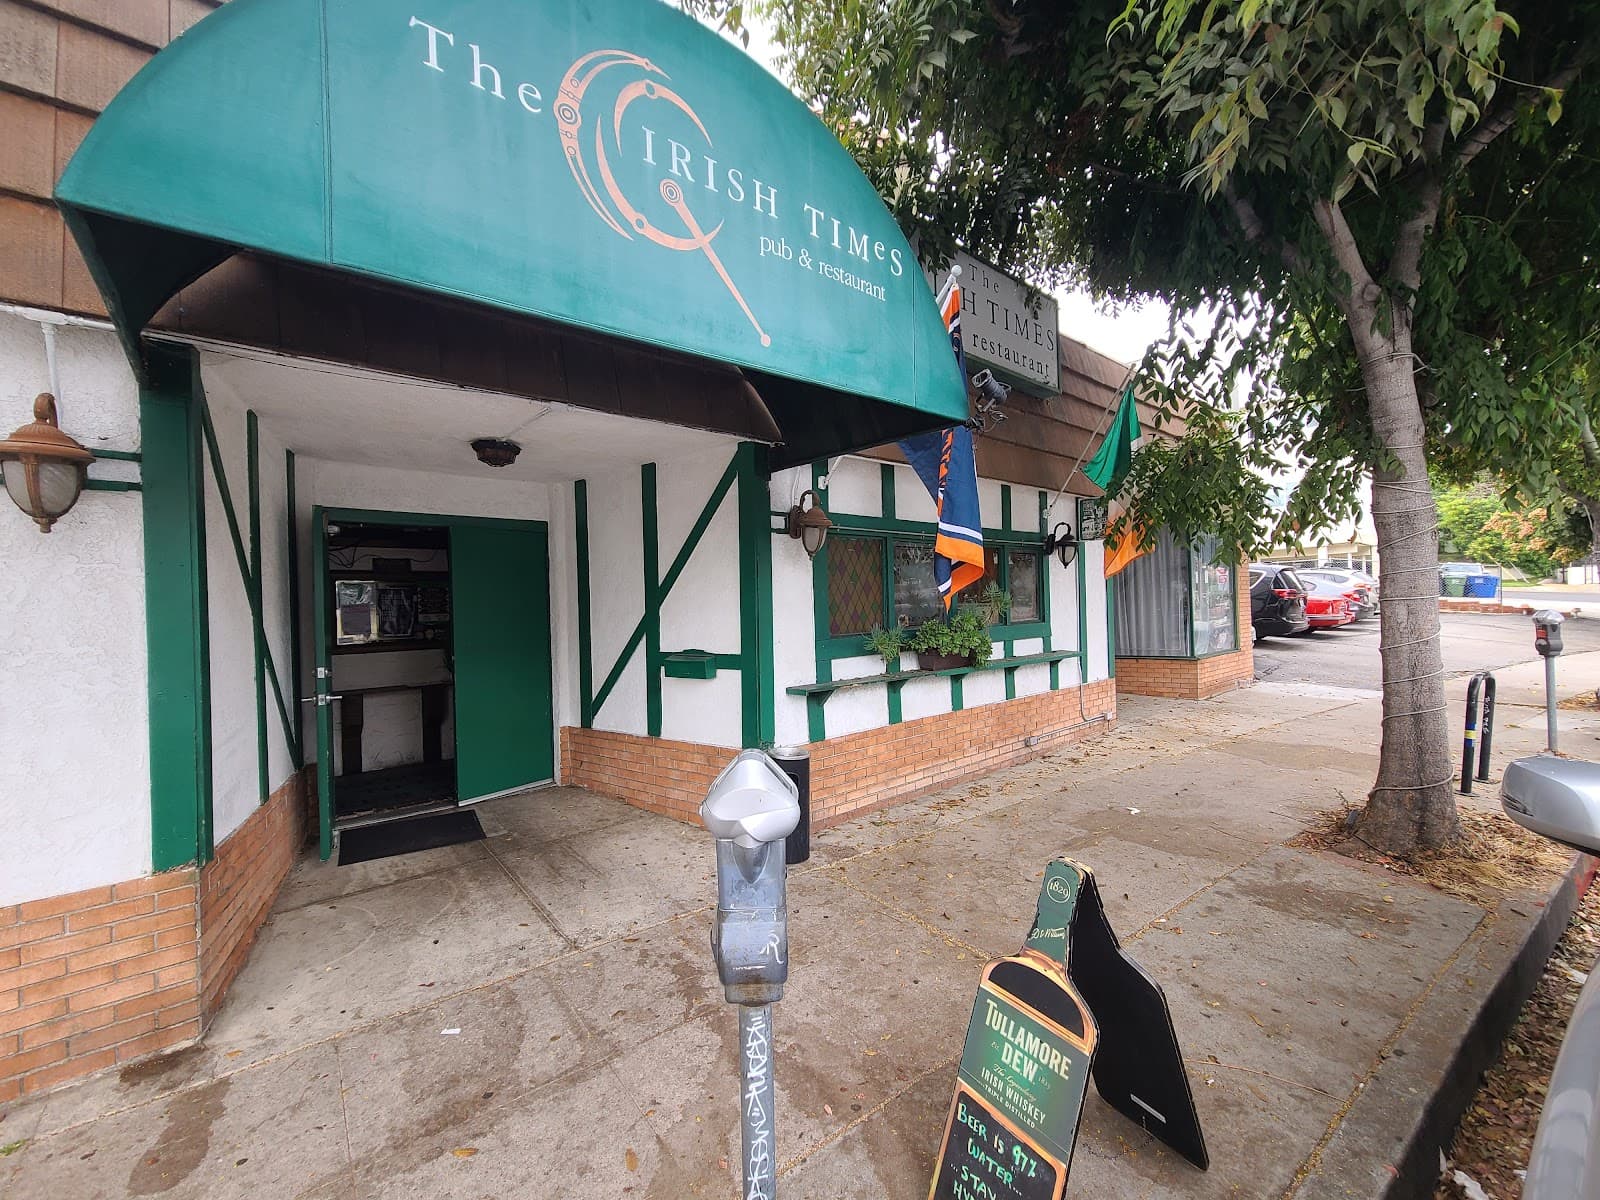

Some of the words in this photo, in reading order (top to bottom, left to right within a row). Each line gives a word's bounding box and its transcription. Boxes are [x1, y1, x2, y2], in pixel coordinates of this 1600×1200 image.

[409, 15, 542, 113] The
[641, 125, 779, 219] IRISH
[759, 235, 793, 261] pub
[798, 248, 813, 271] &
[818, 260, 886, 302] restaurant
[968, 263, 999, 294] The
[972, 331, 1050, 378] restaurant
[986, 299, 1055, 352] TIMES
[1049, 880, 1069, 899] 1829
[985, 998, 1072, 1080] TULLAMORE
[981, 1067, 1004, 1092] IRISH
[1005, 1085, 1046, 1125] WHISKEY
[1004, 1101, 1036, 1129] DISTILLED
[957, 1102, 988, 1142] BEER
[993, 1134, 1005, 1154] IS
[1012, 1144, 1038, 1178] 97%
